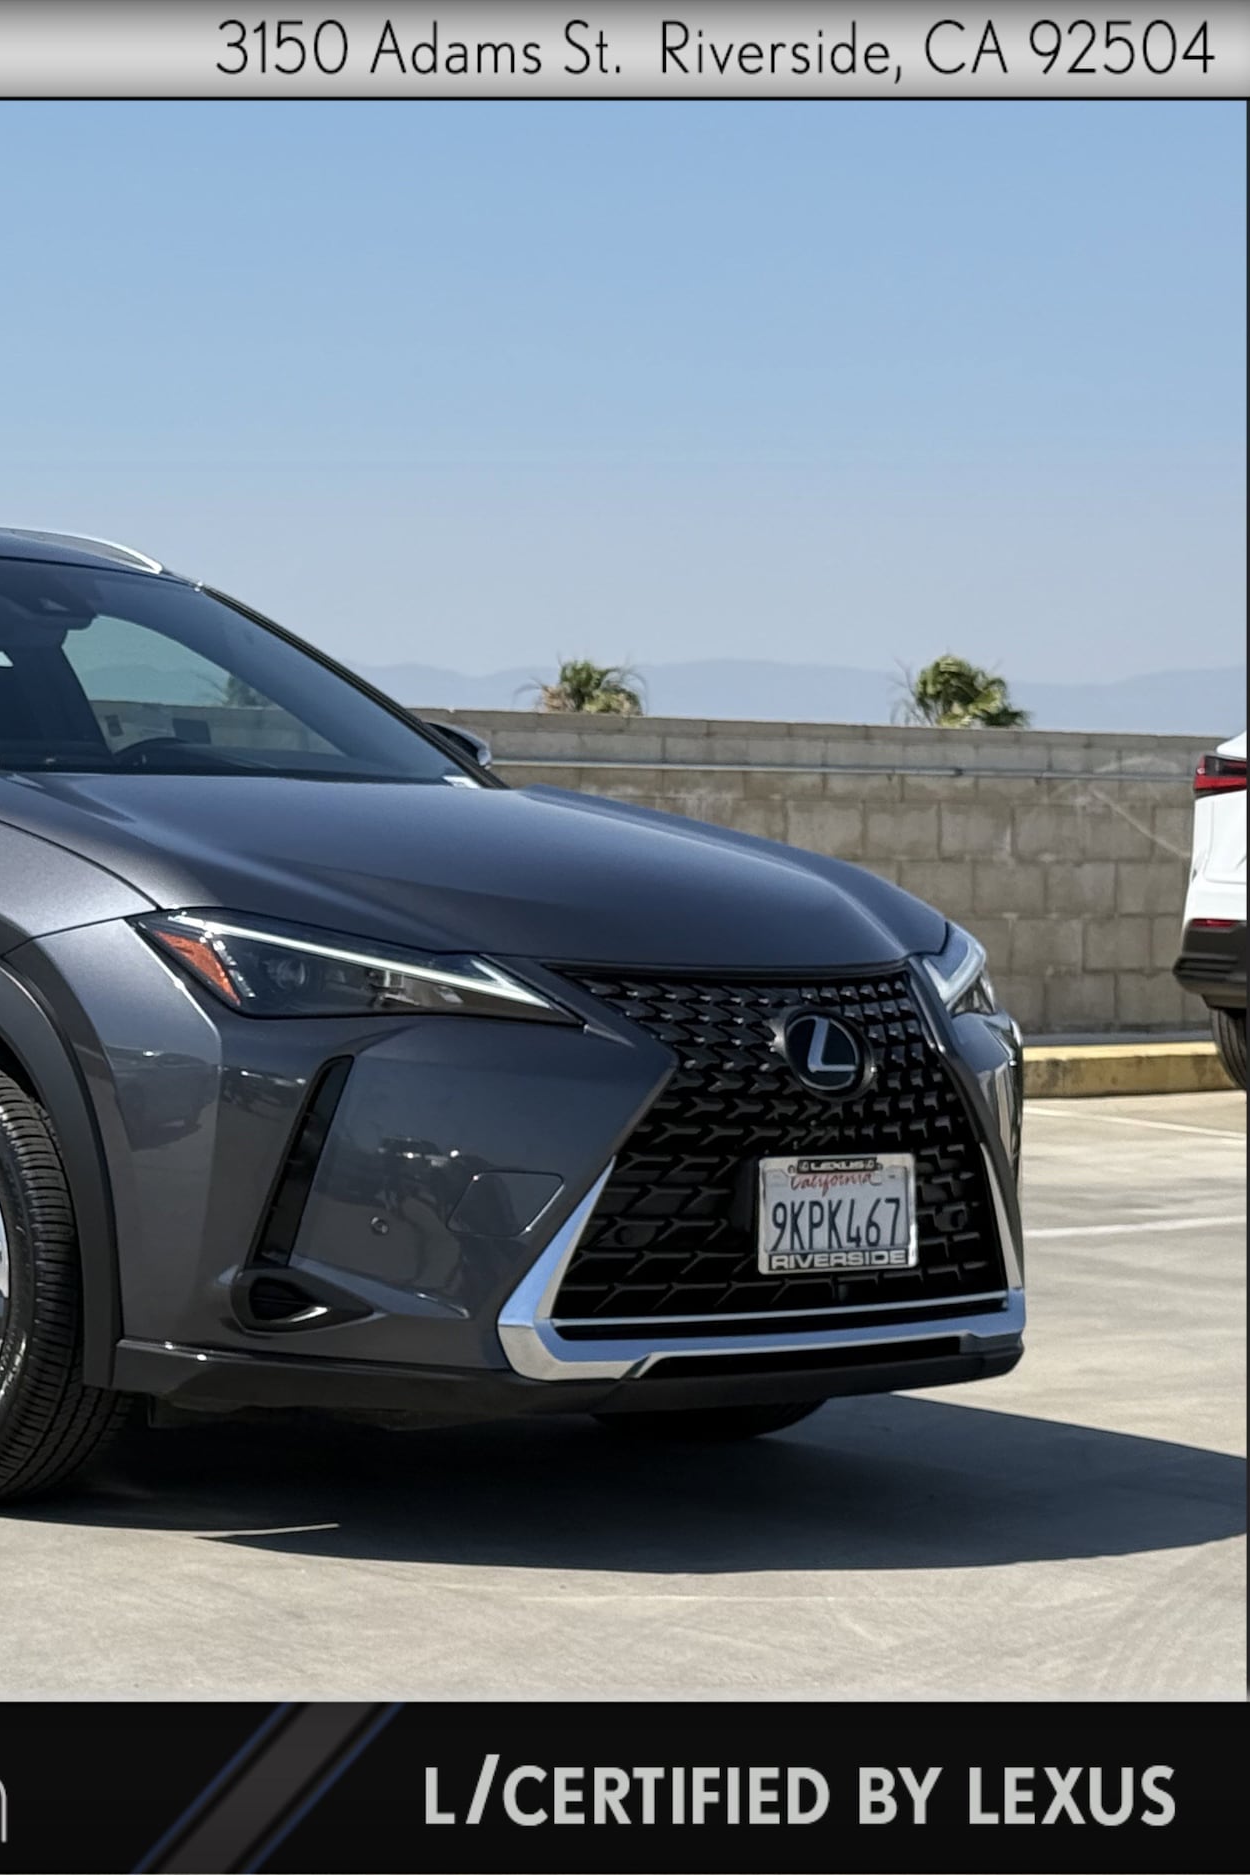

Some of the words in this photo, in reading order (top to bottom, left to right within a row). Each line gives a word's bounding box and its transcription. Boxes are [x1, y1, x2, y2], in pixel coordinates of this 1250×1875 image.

[810, 1160, 865, 1171] LEXUS
[790, 1172, 882, 1197] California
[770, 1198, 901, 1252] 9KPK467
[771, 1250, 907, 1270] RIVERSIDE
